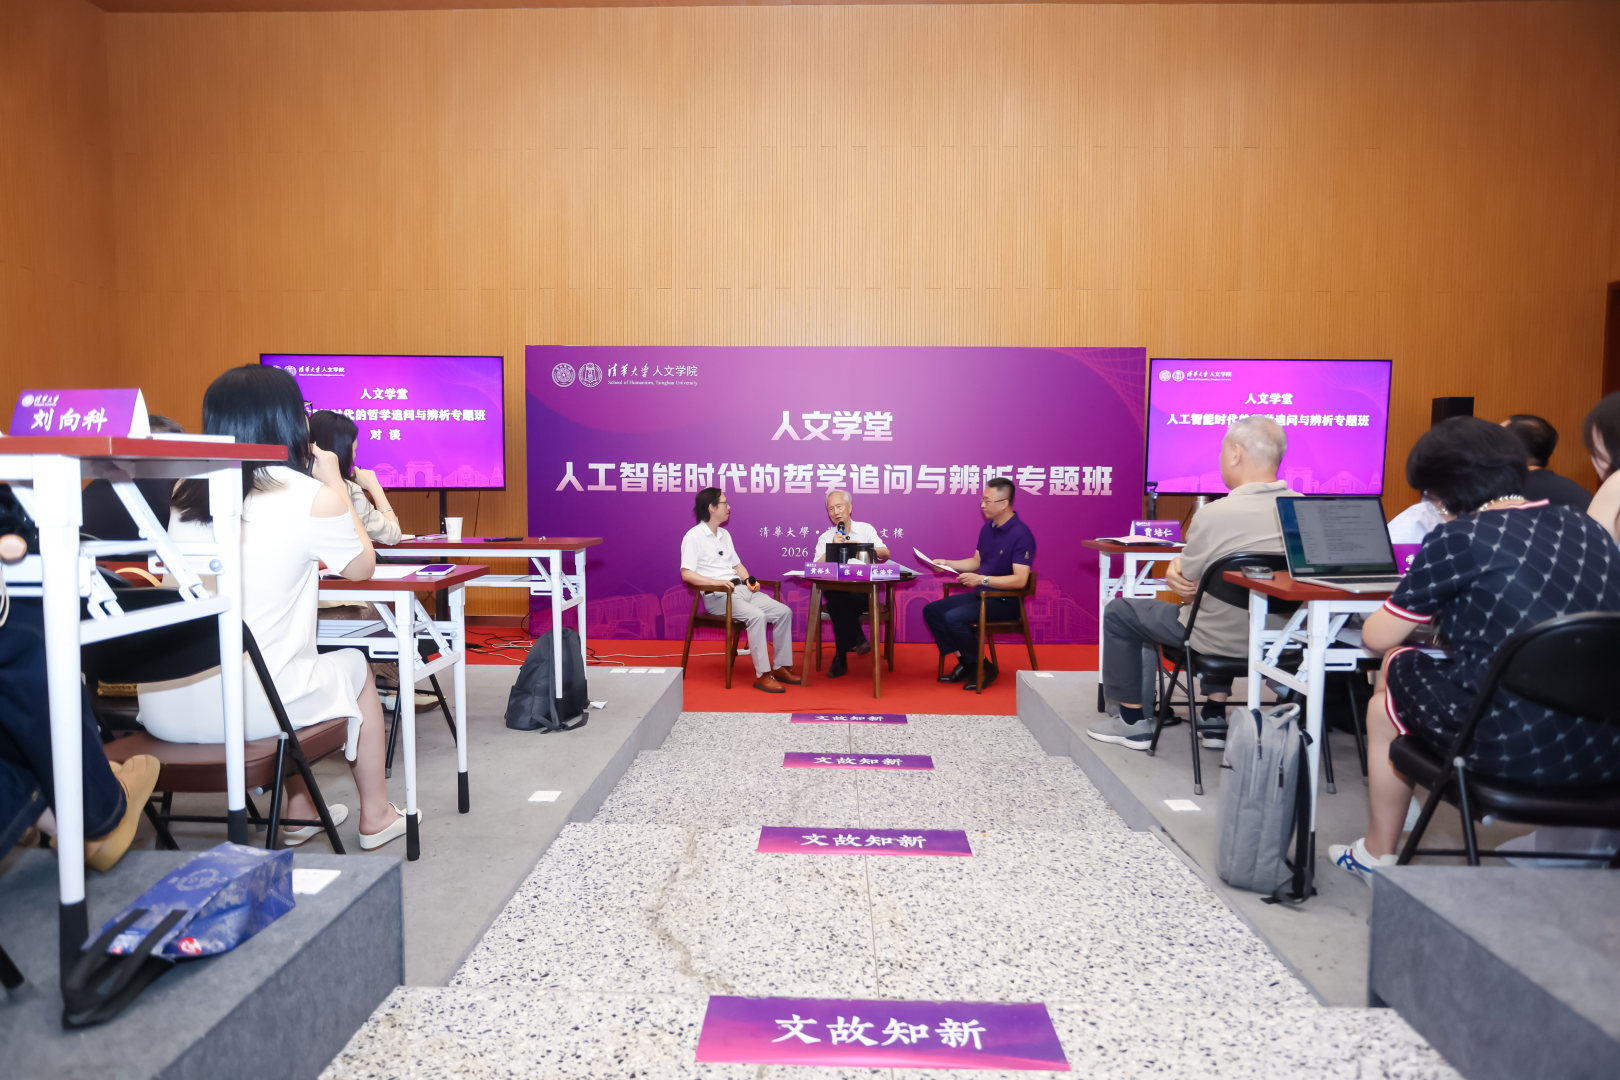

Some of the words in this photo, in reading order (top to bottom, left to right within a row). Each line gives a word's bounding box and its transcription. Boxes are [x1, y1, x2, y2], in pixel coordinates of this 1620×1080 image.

[360, 388, 408, 400] 人文学堂
[1245, 393, 1293, 405] 人文学堂
[31, 407, 108, 433] 刘向科
[305, 409, 487, 422] 代的哲学追问与辨析专题班
[1166, 413, 1370, 427] 人工智能时代追问与辨析专题班
[772, 411, 893, 441] 人文学堂
[556, 461, 1113, 496] 人工智能时代的哲学追问与辨析专题班
[781, 547, 809, 557] 2026
[813, 756, 904, 766] 文故知新
[801, 833, 927, 849] 文故知新
[772, 1014, 987, 1050] 文故知新
